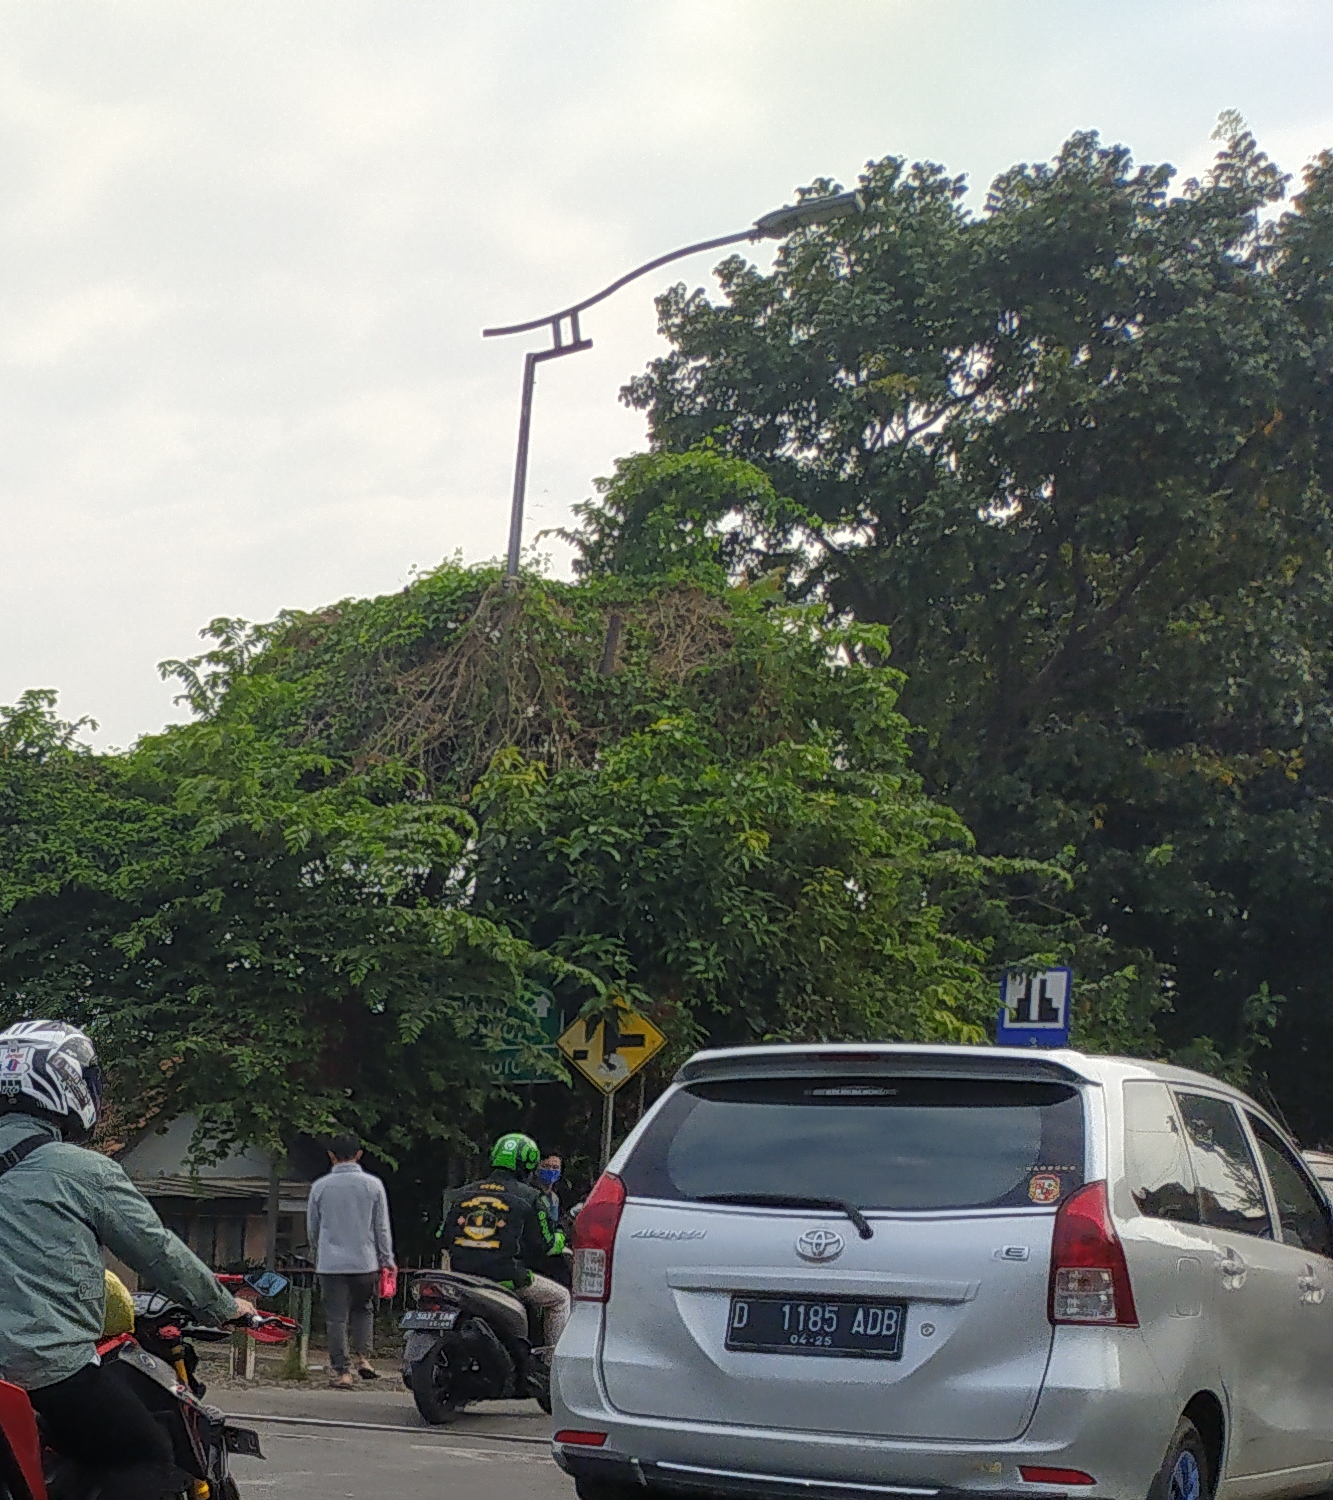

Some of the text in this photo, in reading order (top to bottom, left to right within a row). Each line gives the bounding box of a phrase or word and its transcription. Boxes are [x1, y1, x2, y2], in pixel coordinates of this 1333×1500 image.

[733, 1302, 898, 1336] D 1185 ADB
